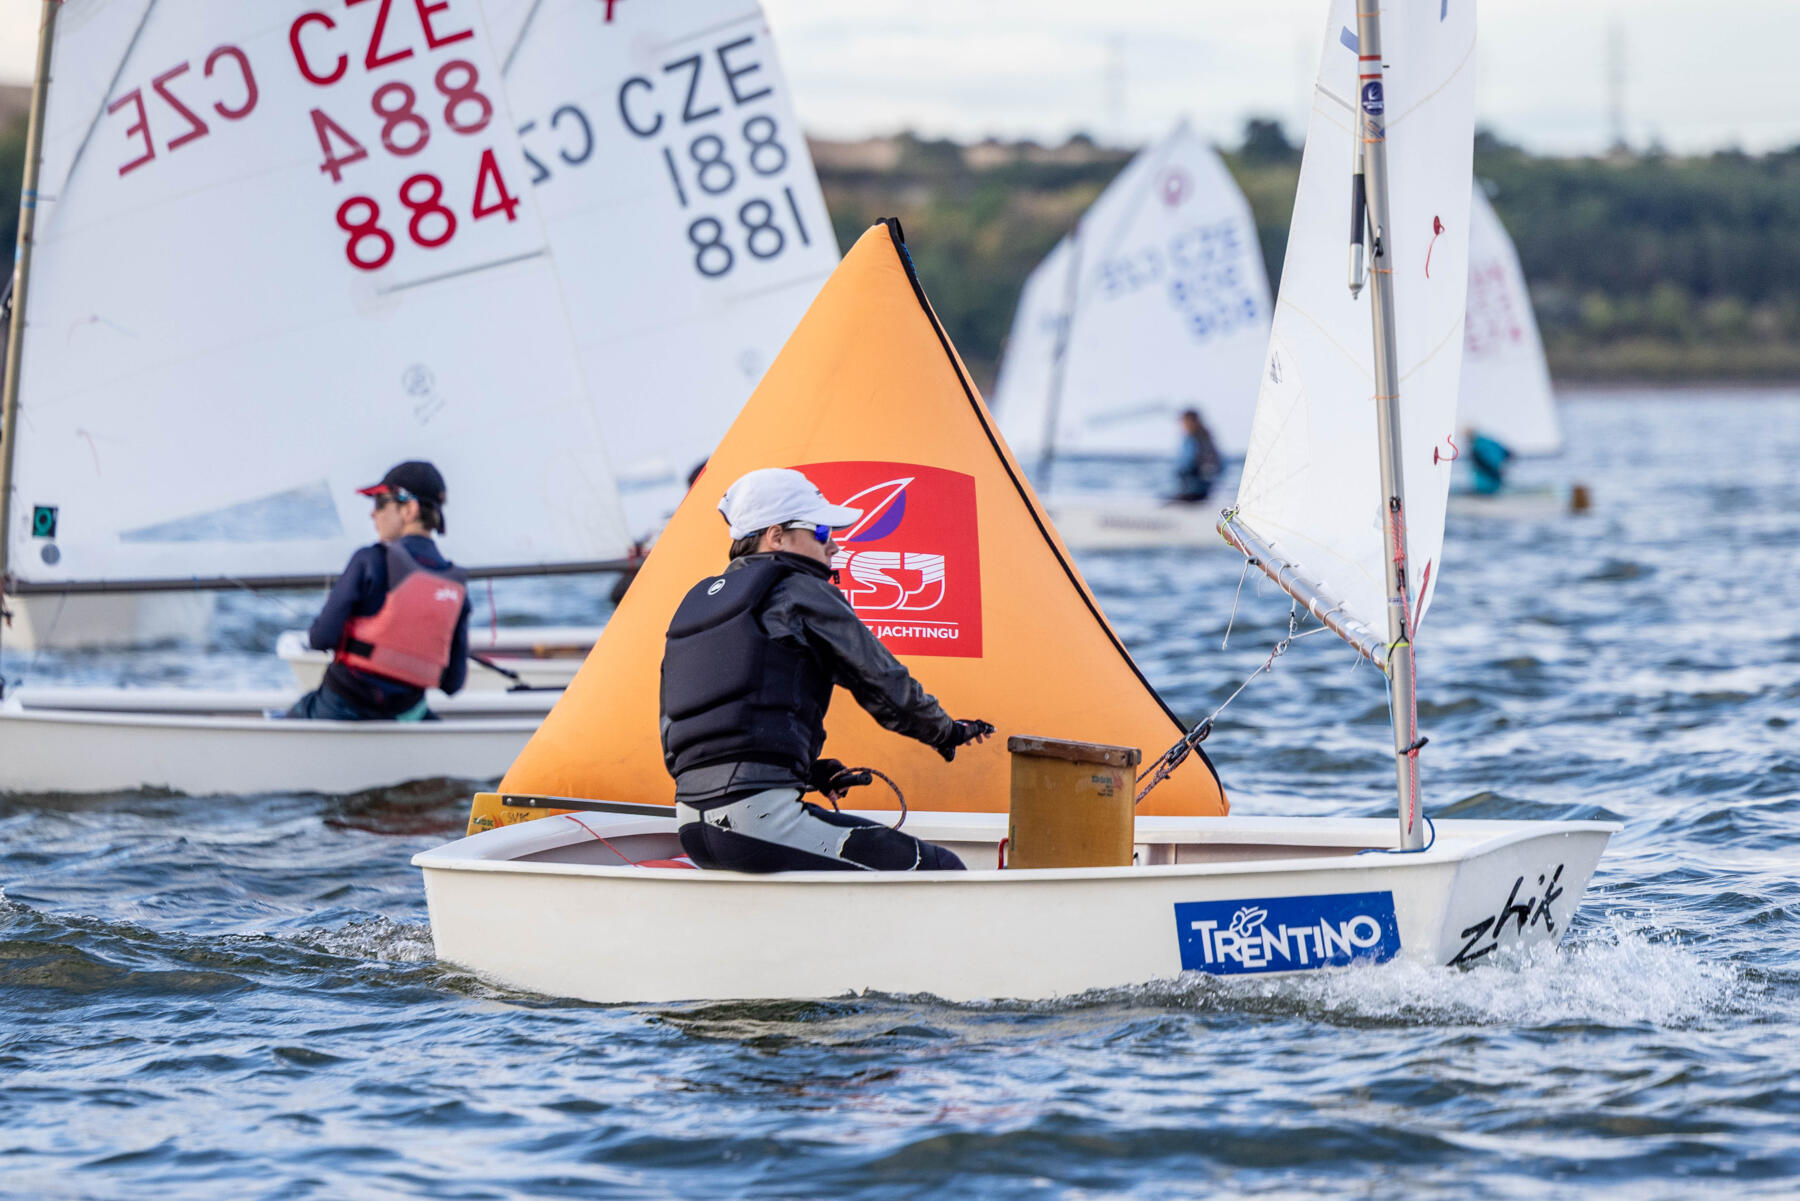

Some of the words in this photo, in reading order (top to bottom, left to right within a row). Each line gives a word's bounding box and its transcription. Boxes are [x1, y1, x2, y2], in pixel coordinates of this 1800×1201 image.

[289, 0, 474, 87] CZE
[617, 36, 773, 138] CZE
[336, 148, 520, 271] 884
[687, 187, 811, 278] 881
[877, 626, 960, 640] JACHTINGU
